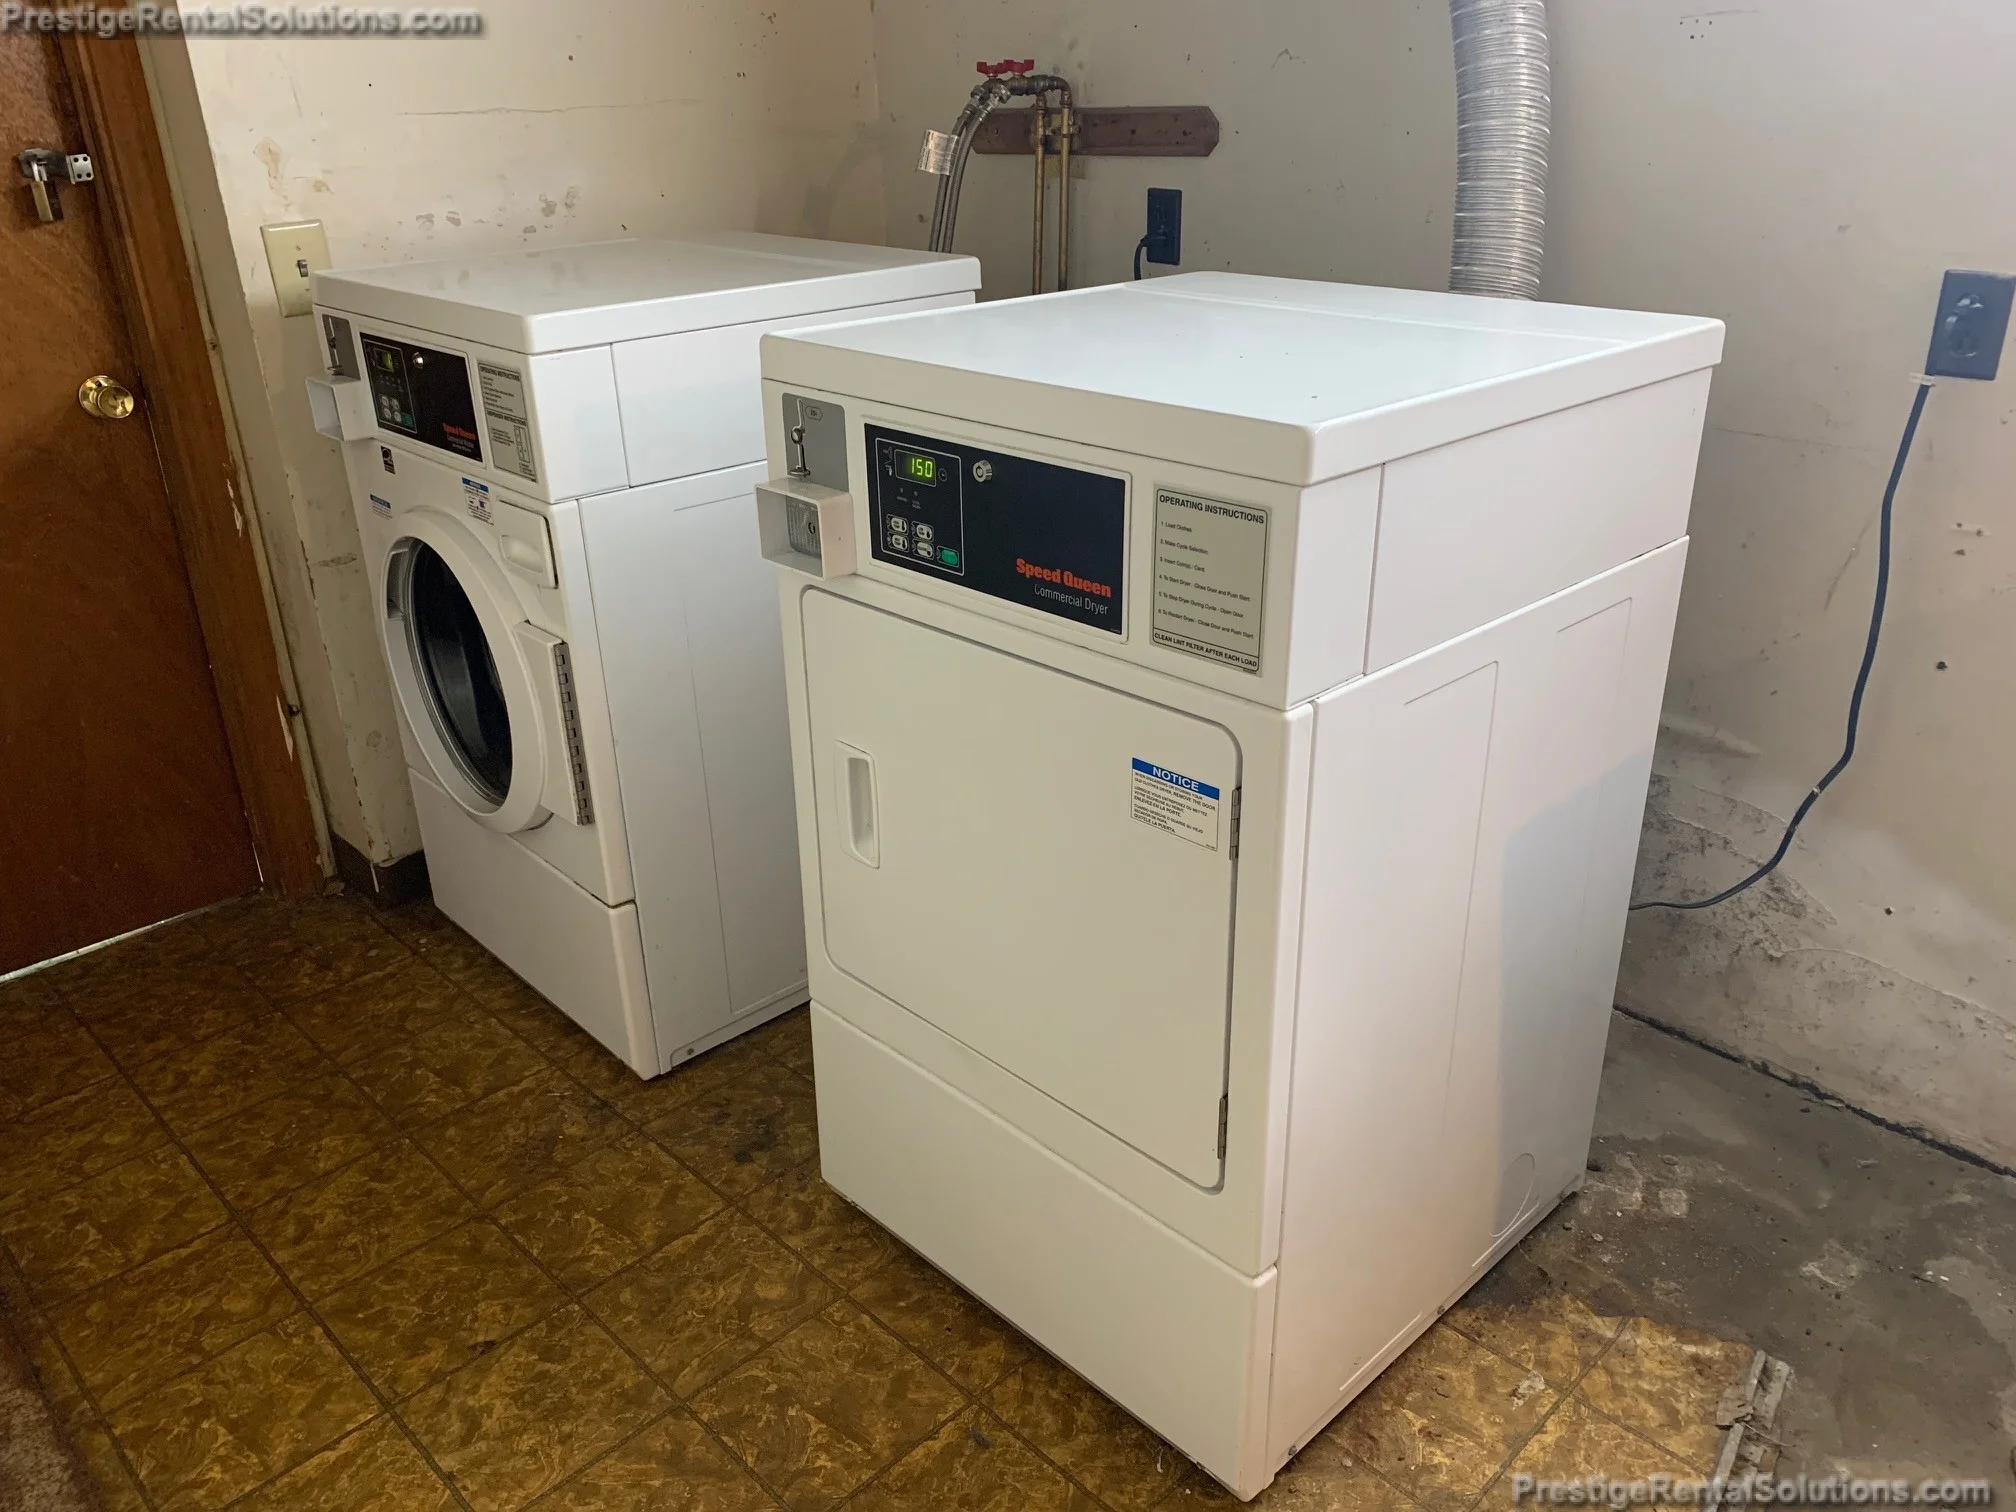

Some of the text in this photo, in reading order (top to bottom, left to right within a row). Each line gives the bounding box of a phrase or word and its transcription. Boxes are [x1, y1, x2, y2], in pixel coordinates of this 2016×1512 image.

[912, 458, 933, 478] 150
[1159, 495, 1264, 524] OPERATING INSTRUCTIONS
[1016, 558, 1111, 598] Speed Queen
[1034, 584, 1108, 615] Commercial Dryer
[1154, 632, 1257, 667] CLEAN LINT FILTER AFTER EACH LOAD
[1153, 767, 1199, 791] NOTICE
[1174, 792, 1192, 802] REMOVE
